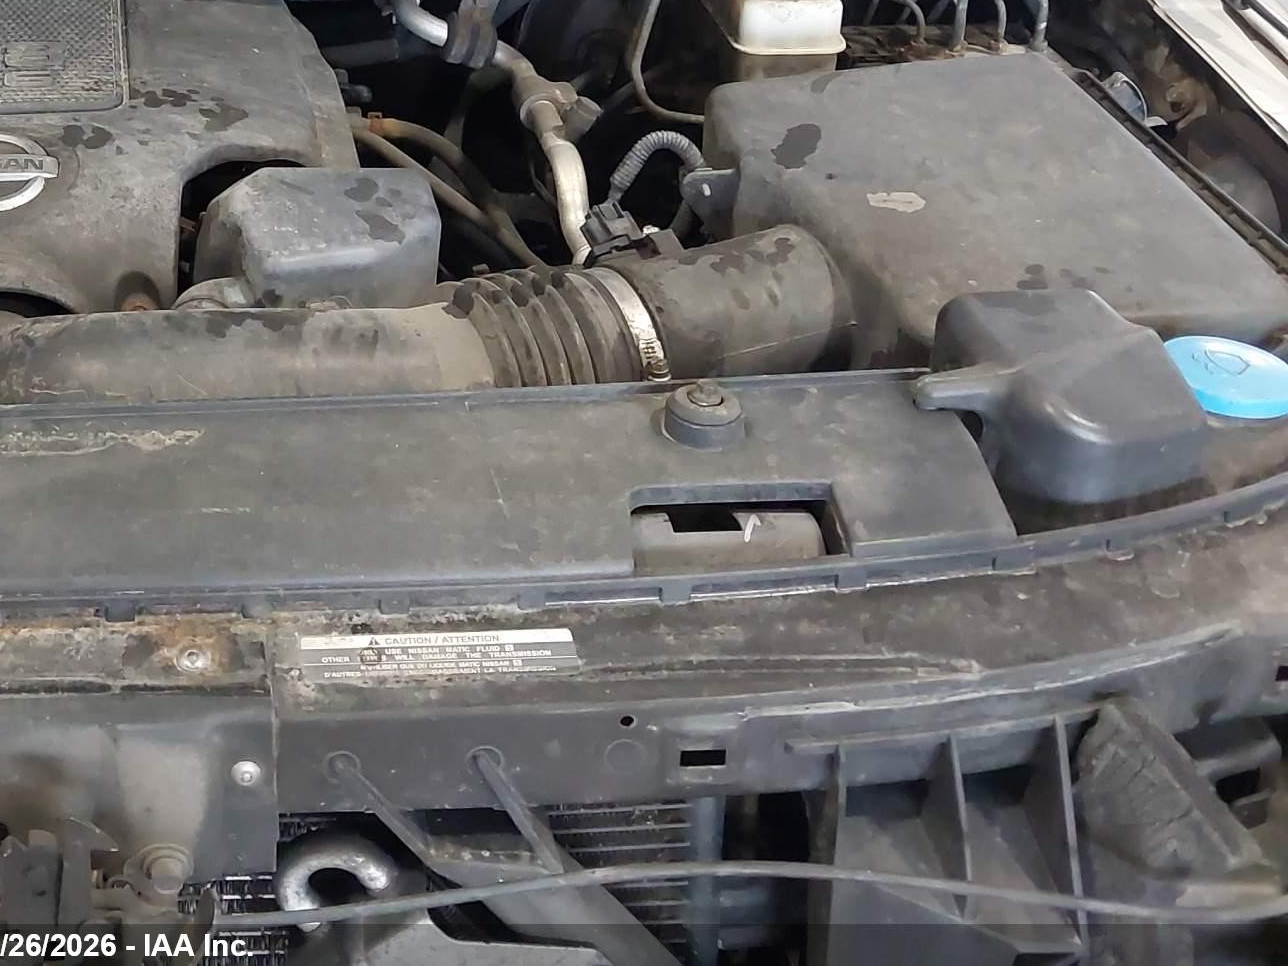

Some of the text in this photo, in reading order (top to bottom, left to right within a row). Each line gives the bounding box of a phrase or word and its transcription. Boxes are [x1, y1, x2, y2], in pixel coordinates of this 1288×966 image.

[384, 636, 432, 645] CAUTION
[441, 634, 500, 643] ATTENTION
[488, 649, 552, 658] TRANSMISSION
